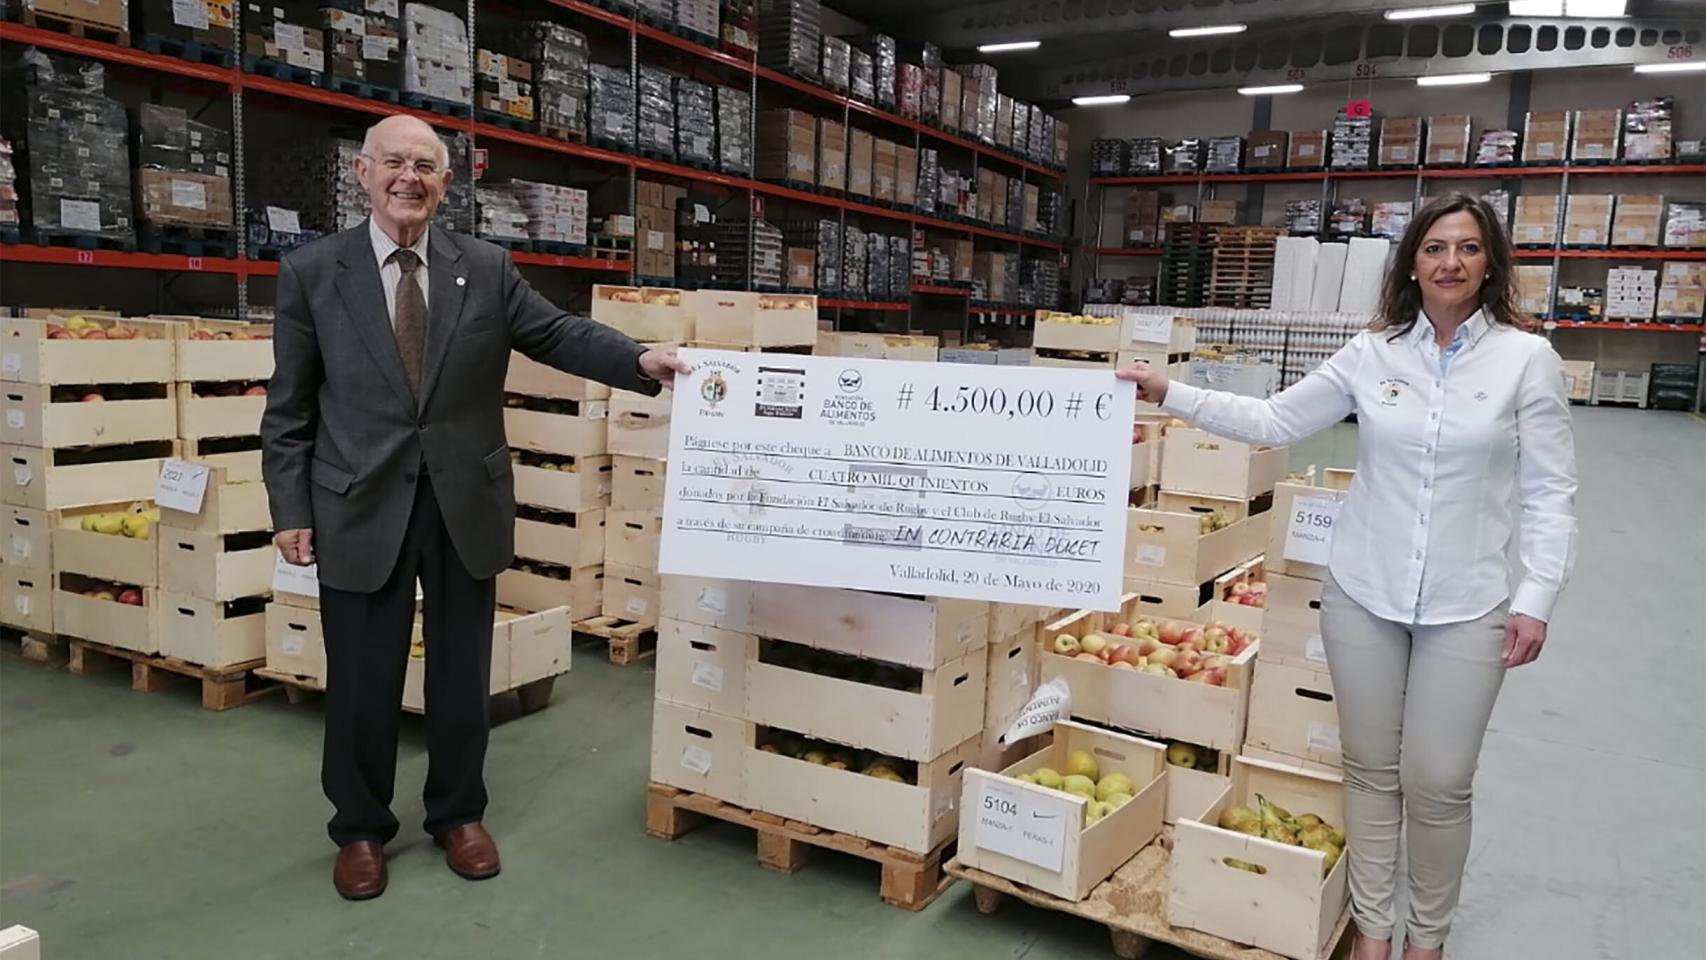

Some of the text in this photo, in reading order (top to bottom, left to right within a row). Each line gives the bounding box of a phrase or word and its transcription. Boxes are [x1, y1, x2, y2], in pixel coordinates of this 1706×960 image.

[1668, 46, 1692, 59] 506
[1354, 103, 1364, 115] G
[823, 399, 873, 411] BANCO DE
[897, 382, 1113, 421] # 4.500,00 # €
[820, 409, 876, 421] ALIMENTOS
[684, 434, 1108, 472] Páguese por este cheque a BANCO DE ALIMENTOS DE VALLADOLID
[681, 461, 1105, 501] la cantidad de CUATRO MIL QUINIENTOS EUROS
[679, 486, 723, 498] donados
[726, 492, 744, 503] por
[747, 491, 758, 501] la
[759, 491, 815, 506] Fundación
[817, 495, 829, 507] El
[831, 497, 877, 513] Salvador
[879, 501, 893, 512] de
[896, 503, 928, 516] Rugby
[941, 506, 951, 517] el
[954, 506, 981, 520] Club
[983, 508, 997, 520] de
[1000, 510, 1033, 525] Rugby
[1038, 511, 1051, 524] El
[1053, 514, 1101, 529] Salvador
[1295, 511, 1332, 528] 5159
[676, 518, 683, 526] a
[685, 518, 715, 527] través
[717, 518, 731, 529] de
[747, 521, 792, 537] campaña
[796, 524, 809, 536] de
[893, 525, 922, 542] IN
[928, 528, 1035, 550] CONTRARIA
[1044, 536, 1100, 556] DUCET
[890, 564, 1101, 593] Valladolid, 20 de Mayo de 2020
[984, 795, 1017, 816] 5104
